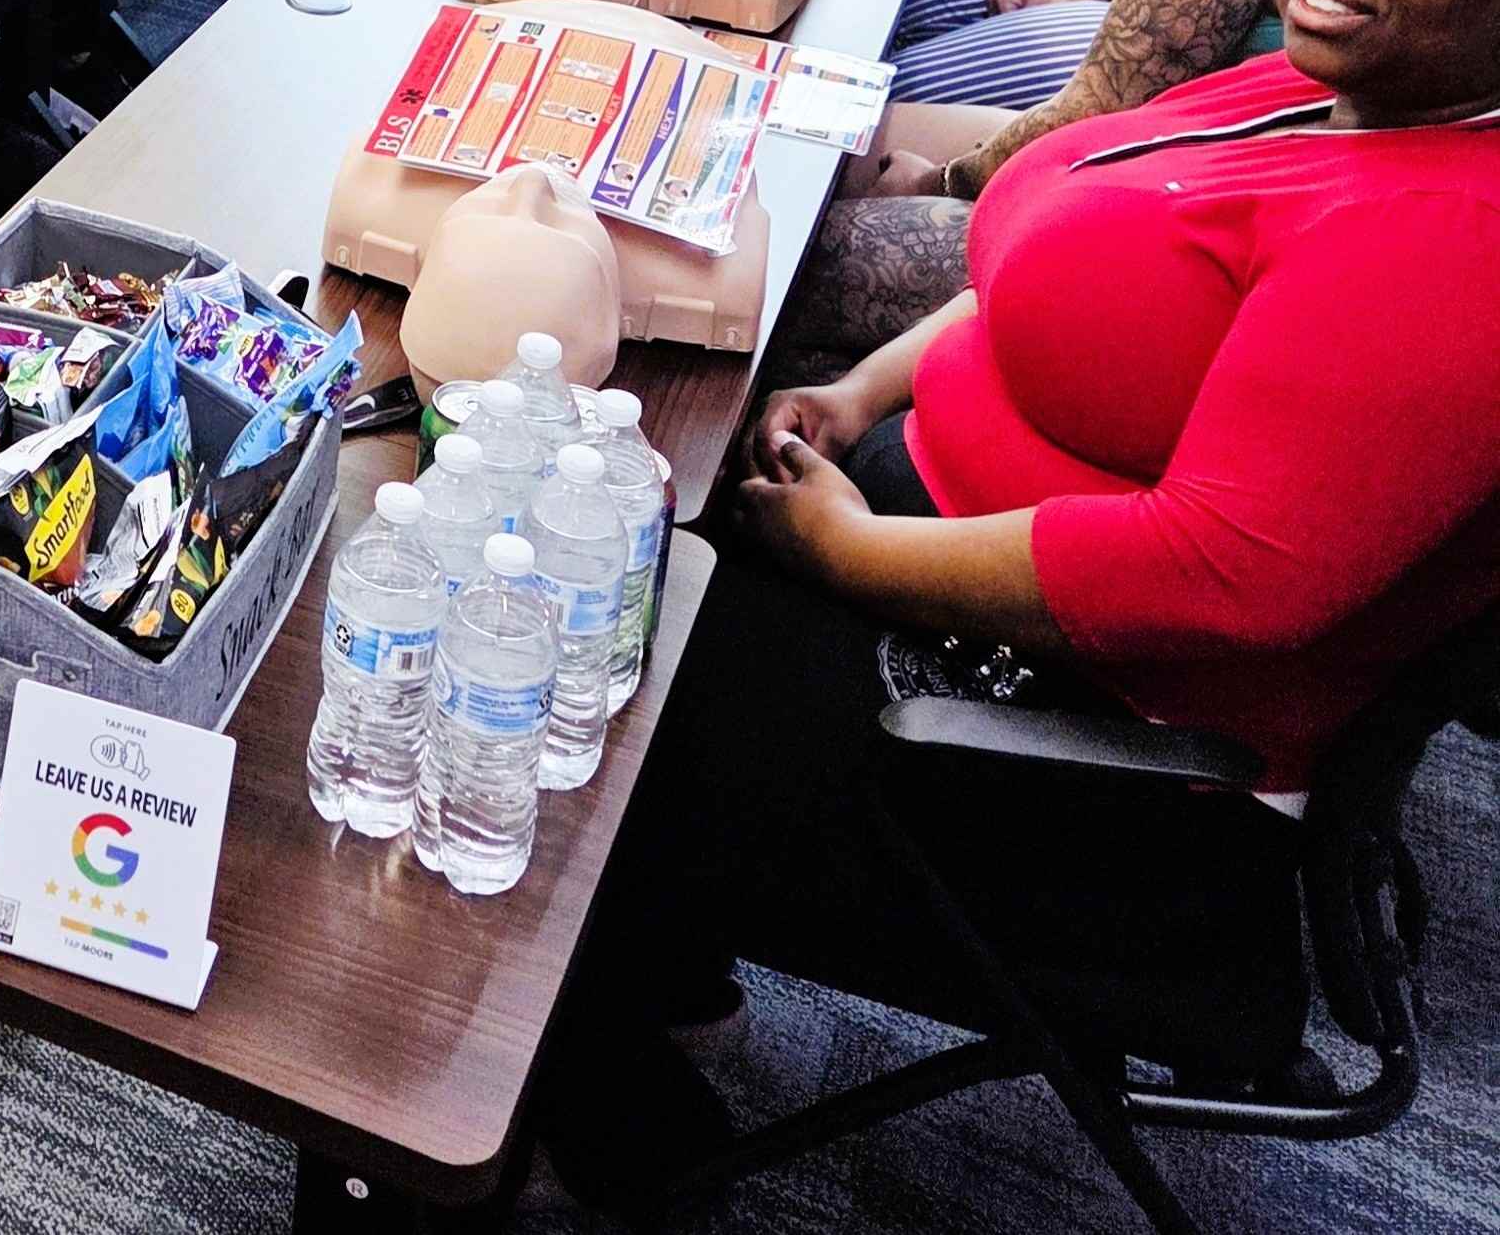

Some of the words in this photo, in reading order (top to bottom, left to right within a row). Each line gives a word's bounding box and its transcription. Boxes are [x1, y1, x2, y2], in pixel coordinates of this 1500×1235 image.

[373, 115, 413, 154] BLS
[656, 107, 676, 141] NEXT
[596, 189, 633, 210] A
[34, 470, 92, 570] Smartfood
[34, 759, 88, 795] LEAVE
[90, 775, 115, 803] US
[114, 784, 128, 807] A
[129, 788, 198, 828] REVIEW
